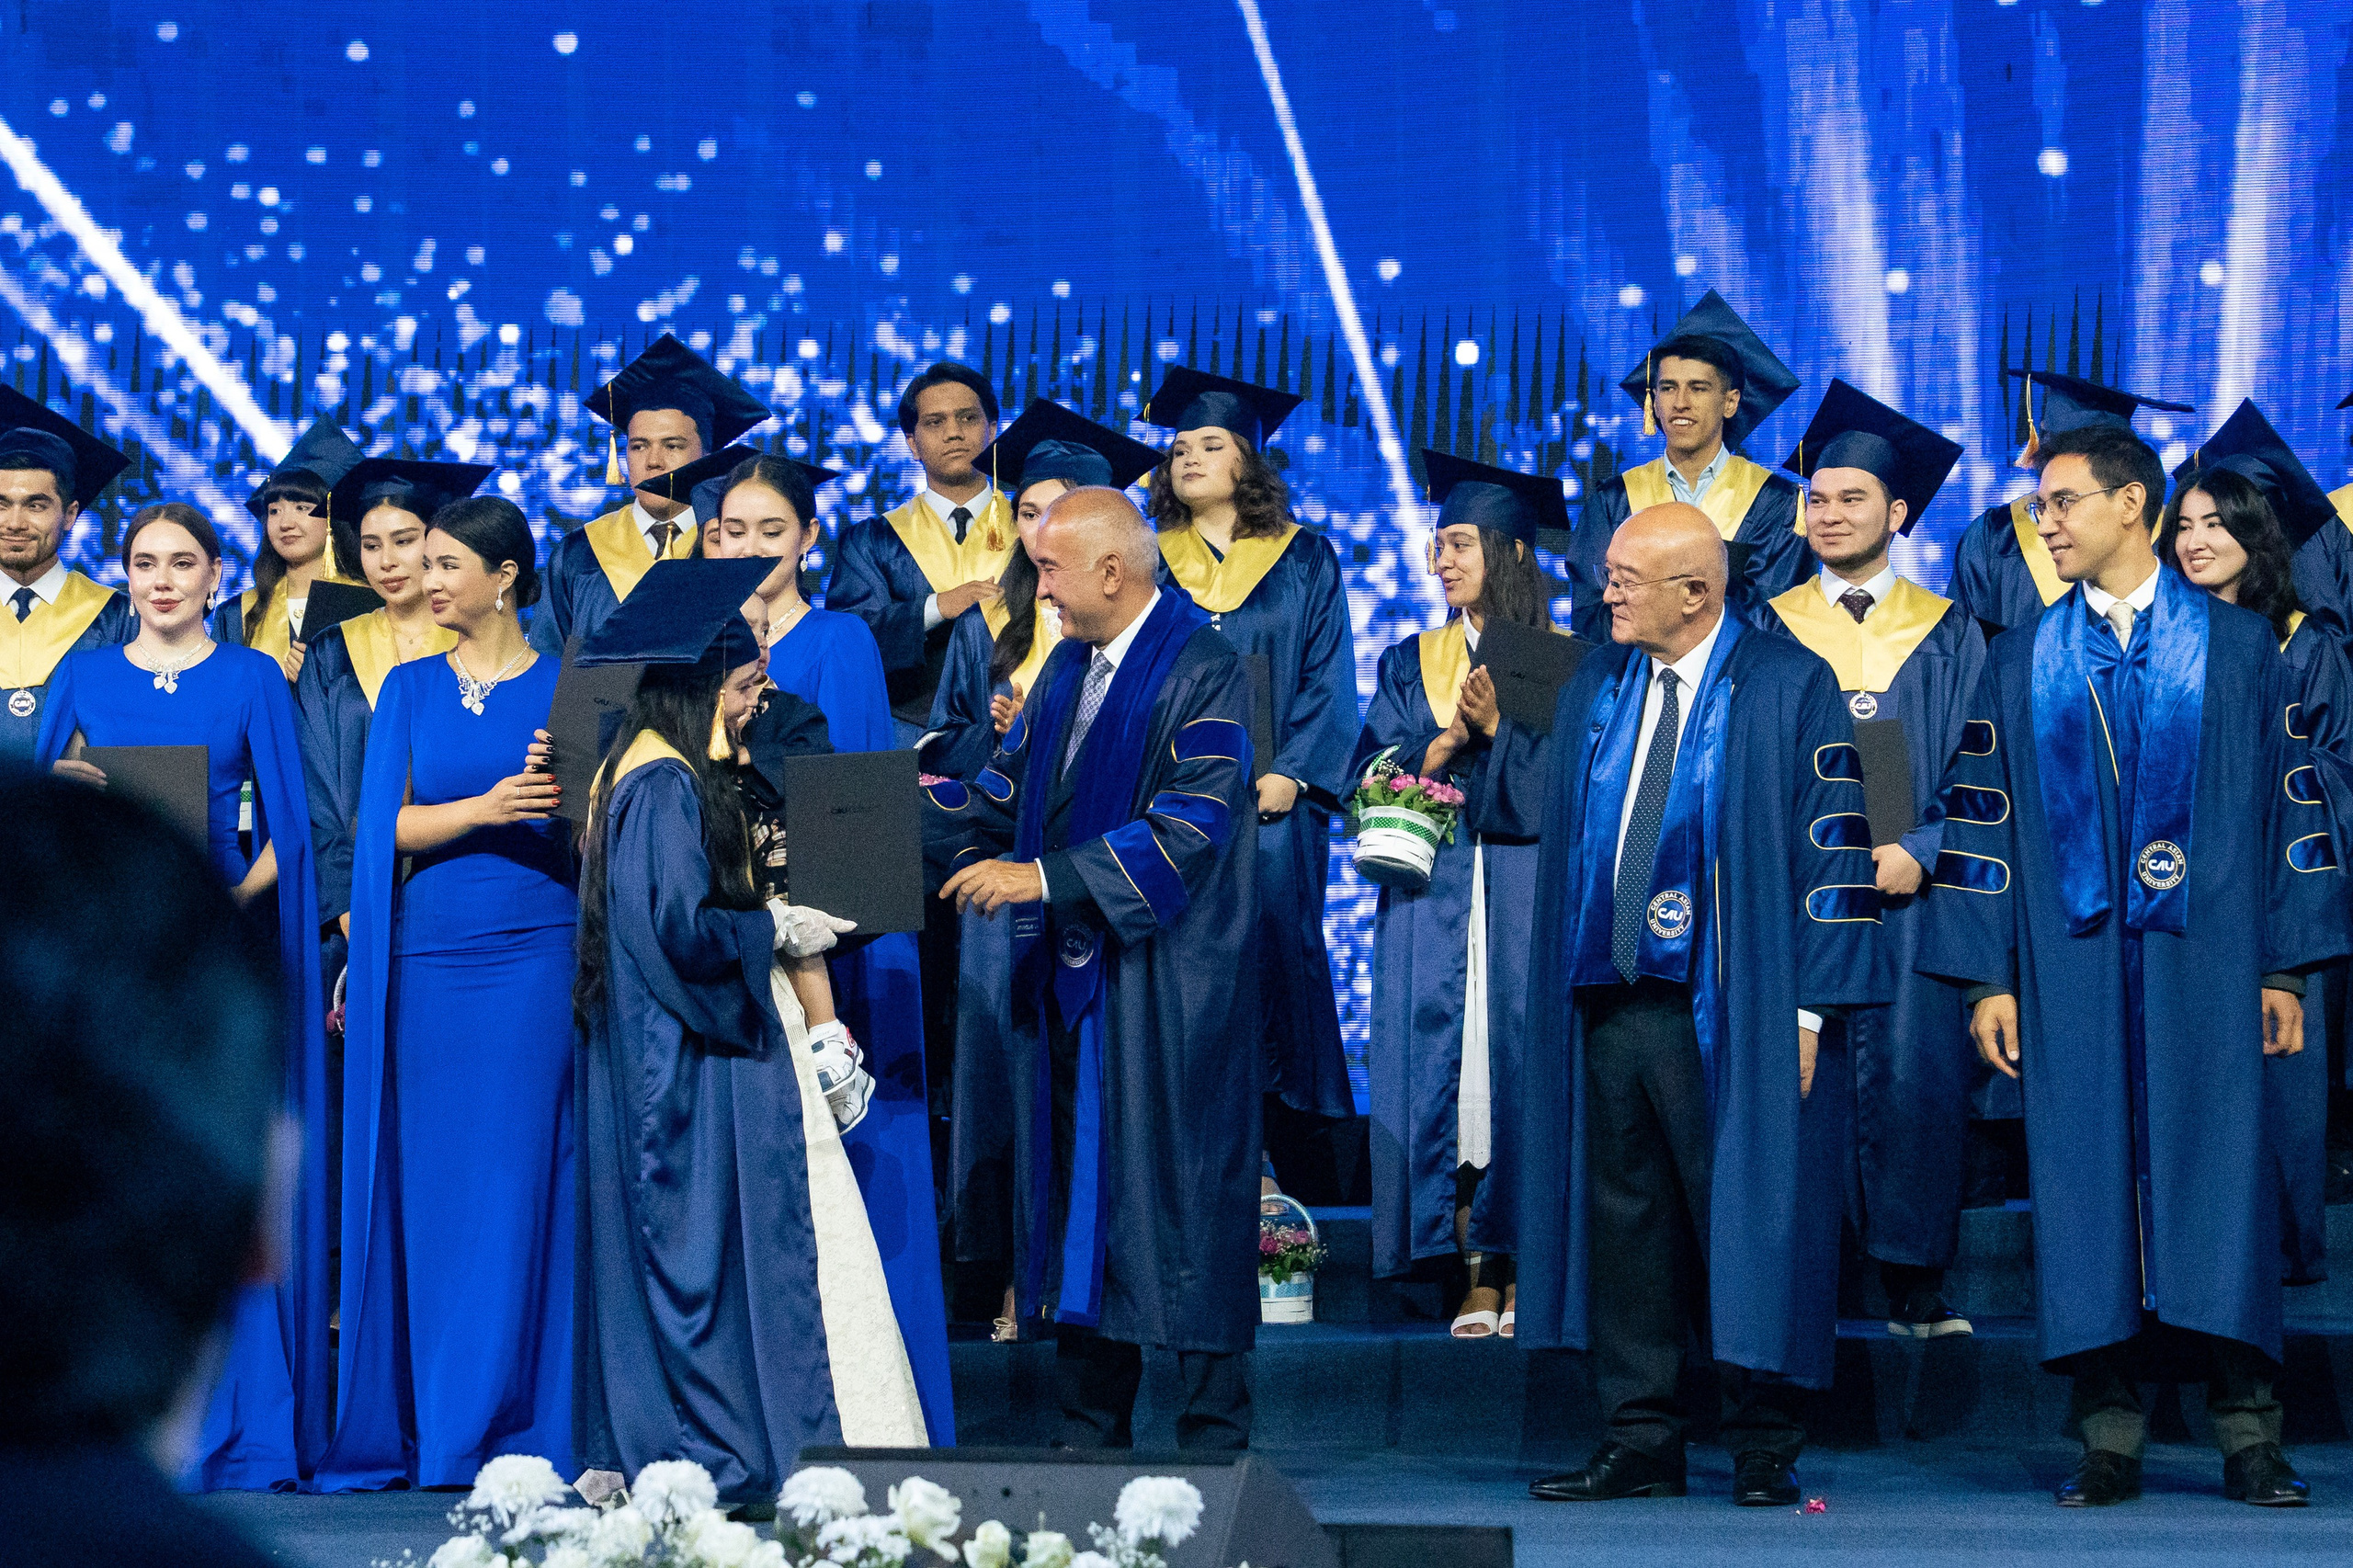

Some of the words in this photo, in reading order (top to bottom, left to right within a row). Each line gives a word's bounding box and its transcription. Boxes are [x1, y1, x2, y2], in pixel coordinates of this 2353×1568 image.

[2141, 843, 2166, 864] CENTRAL
[2167, 846, 2184, 865] ASIAN
[2148, 858, 2176, 872] CAU
[2142, 871, 2180, 888] UNIVERSITY
[1651, 892, 1677, 911] CENTRAL
[1679, 896, 1691, 915] ASIAN
[1657, 907, 1684, 921] CAU
[1650, 918, 1684, 937] UNIVERSITY
[1066, 937, 1086, 950] CAU
